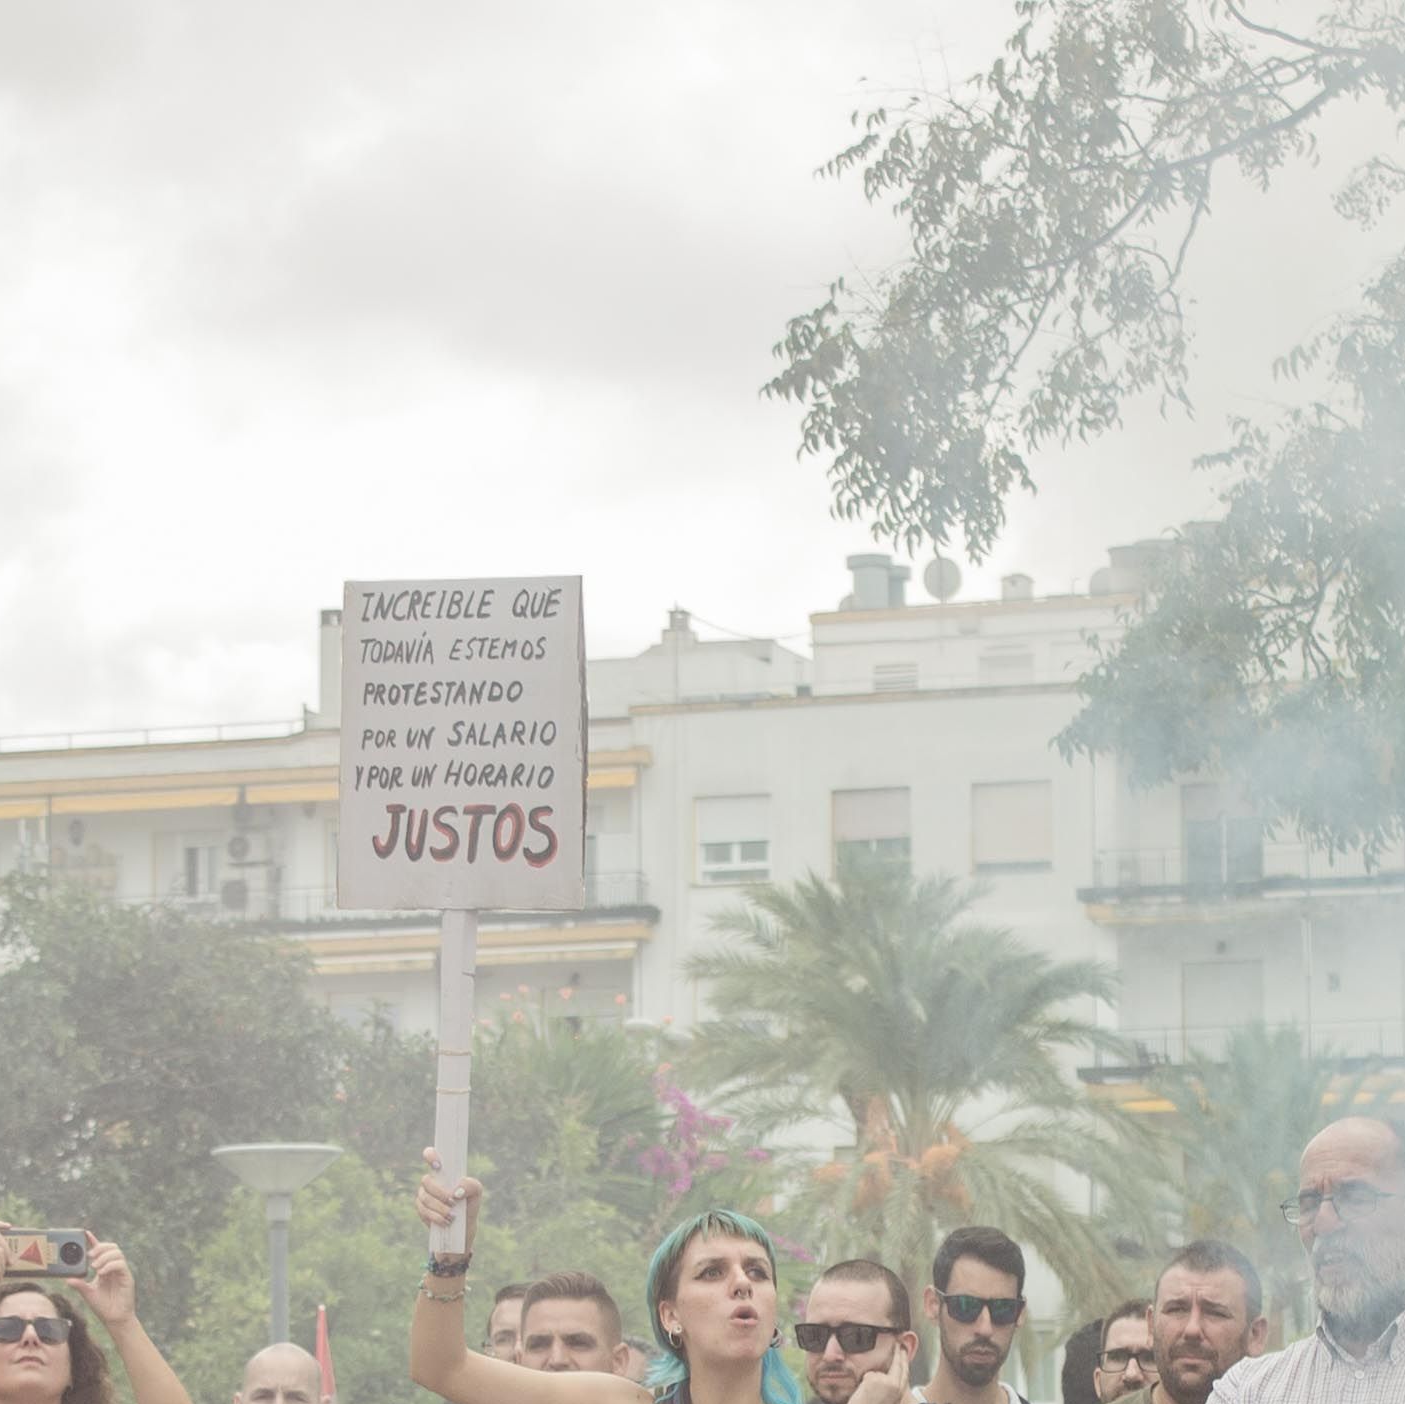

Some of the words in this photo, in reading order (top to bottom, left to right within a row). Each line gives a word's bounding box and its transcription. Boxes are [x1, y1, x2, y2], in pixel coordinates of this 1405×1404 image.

[361, 589, 495, 622] INCREIBLE
[361, 631, 434, 664] TODAVÍA
[448, 636, 547, 661] ESTEMOS
[363, 681, 524, 706] PROTESTANDO
[362, 728, 397, 750] POR
[406, 726, 435, 750] UN
[447, 720, 557, 749] SALARIO
[411, 763, 437, 788] UN
[444, 759, 555, 790] HORARIO
[372, 802, 558, 868] JUSTOS
